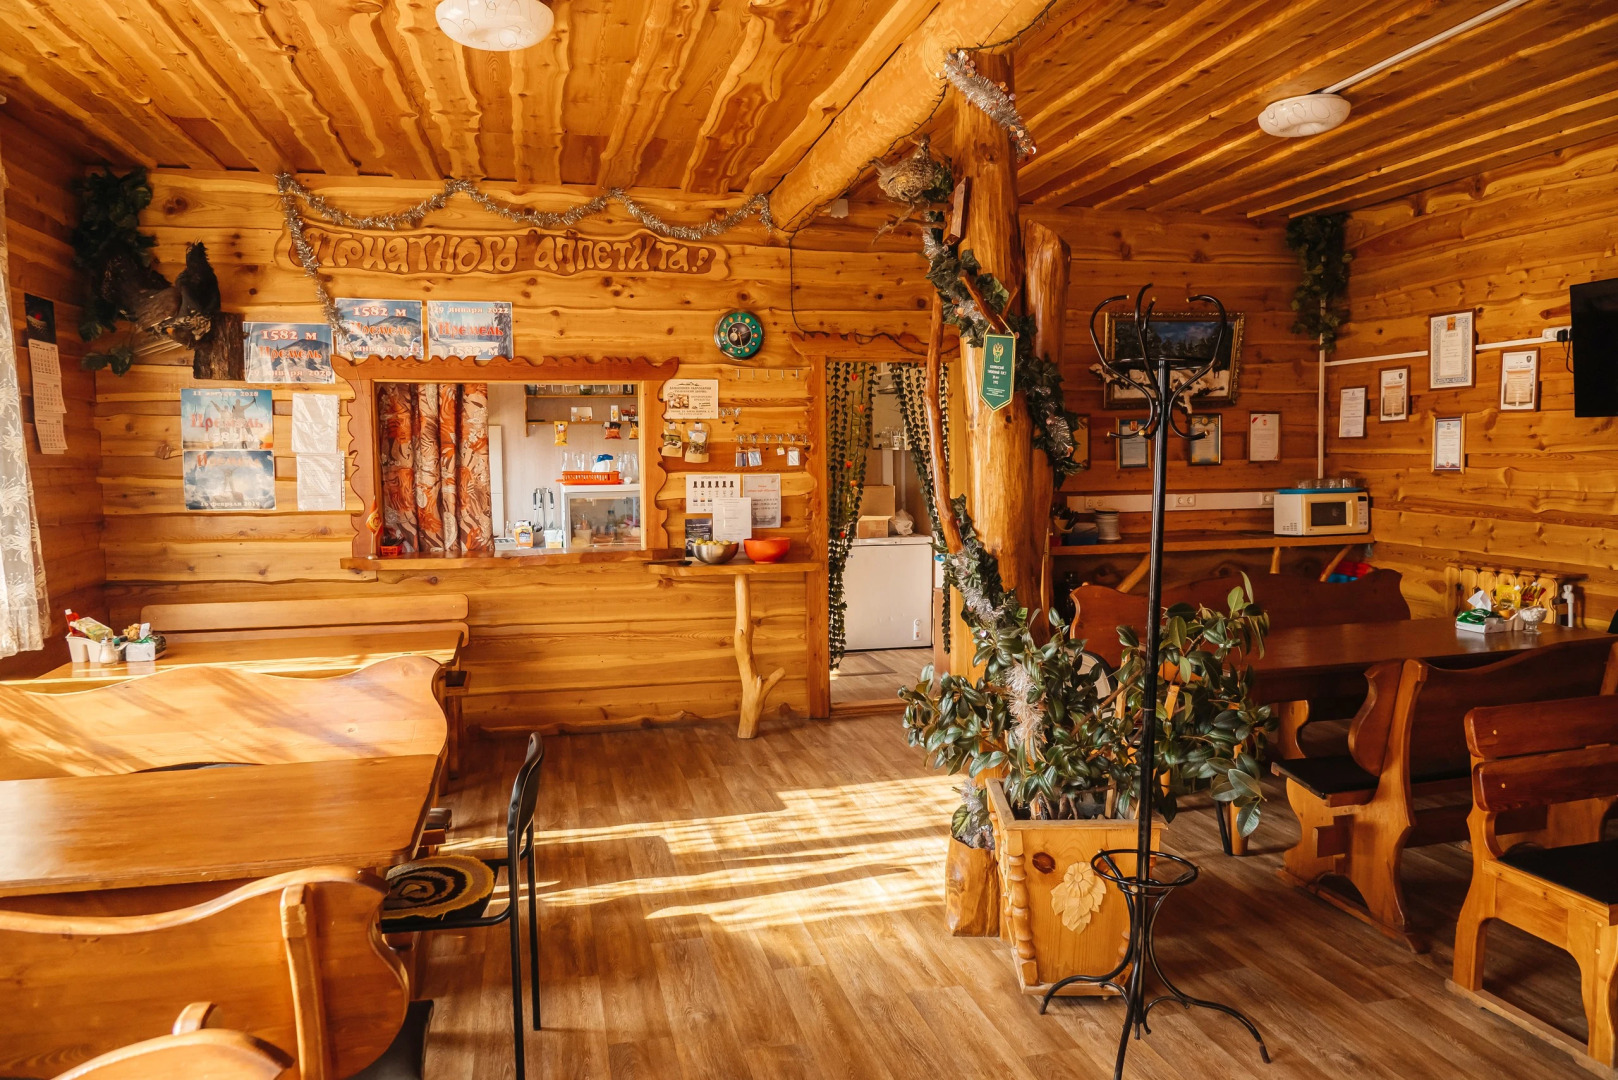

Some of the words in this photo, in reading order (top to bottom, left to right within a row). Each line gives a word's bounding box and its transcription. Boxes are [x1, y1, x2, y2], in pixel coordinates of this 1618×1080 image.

[353, 306, 388, 317] 1582
[448, 306, 483, 314] января
[261, 329, 298, 341] 1582
[438, 321, 504, 338] Иремель
[448, 346, 482, 357] 1582
